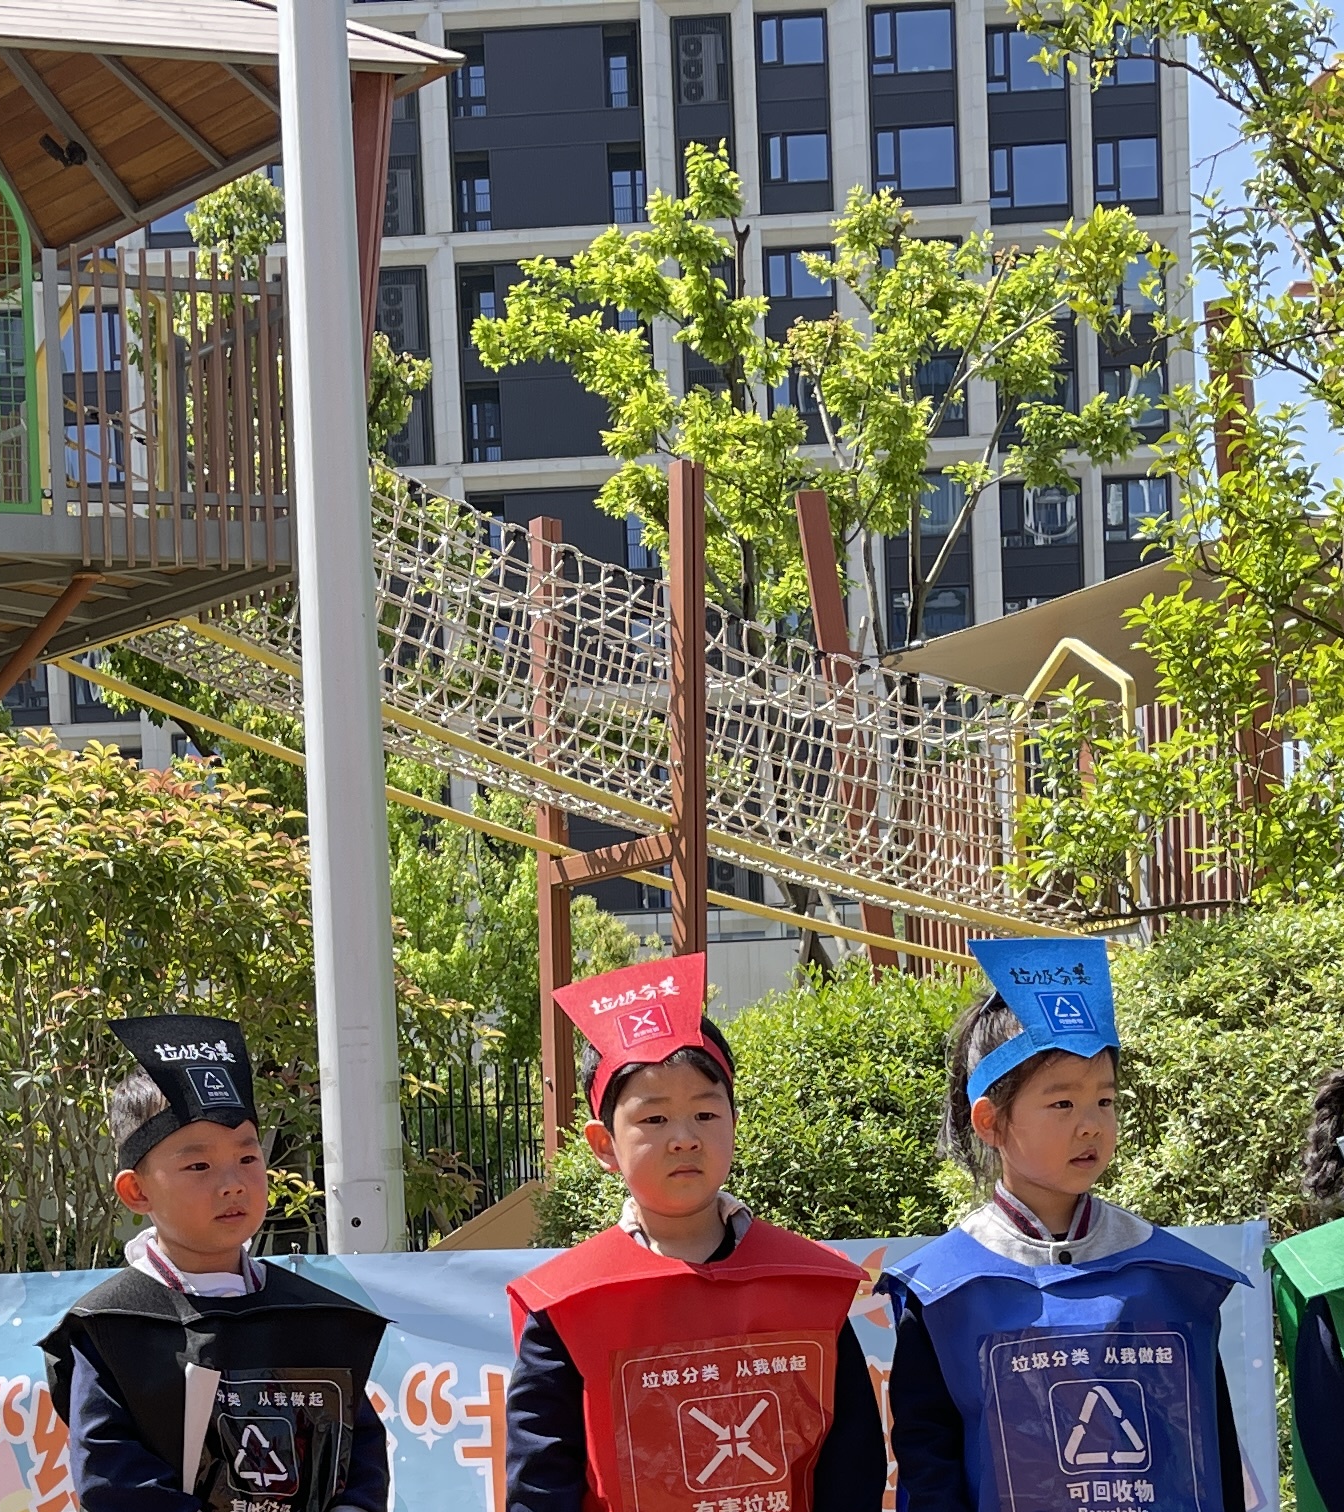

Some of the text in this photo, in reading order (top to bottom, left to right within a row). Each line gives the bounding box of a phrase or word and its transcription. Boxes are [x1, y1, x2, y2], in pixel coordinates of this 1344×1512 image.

[641, 1355, 807, 1389] 垃圾分类 从我做起
[1011, 1347, 1174, 1373] 垃圾分类 从我做起
[257, 1391, 324, 1407] 从我做起
[1066, 1480, 1155, 1504] 可回收物
